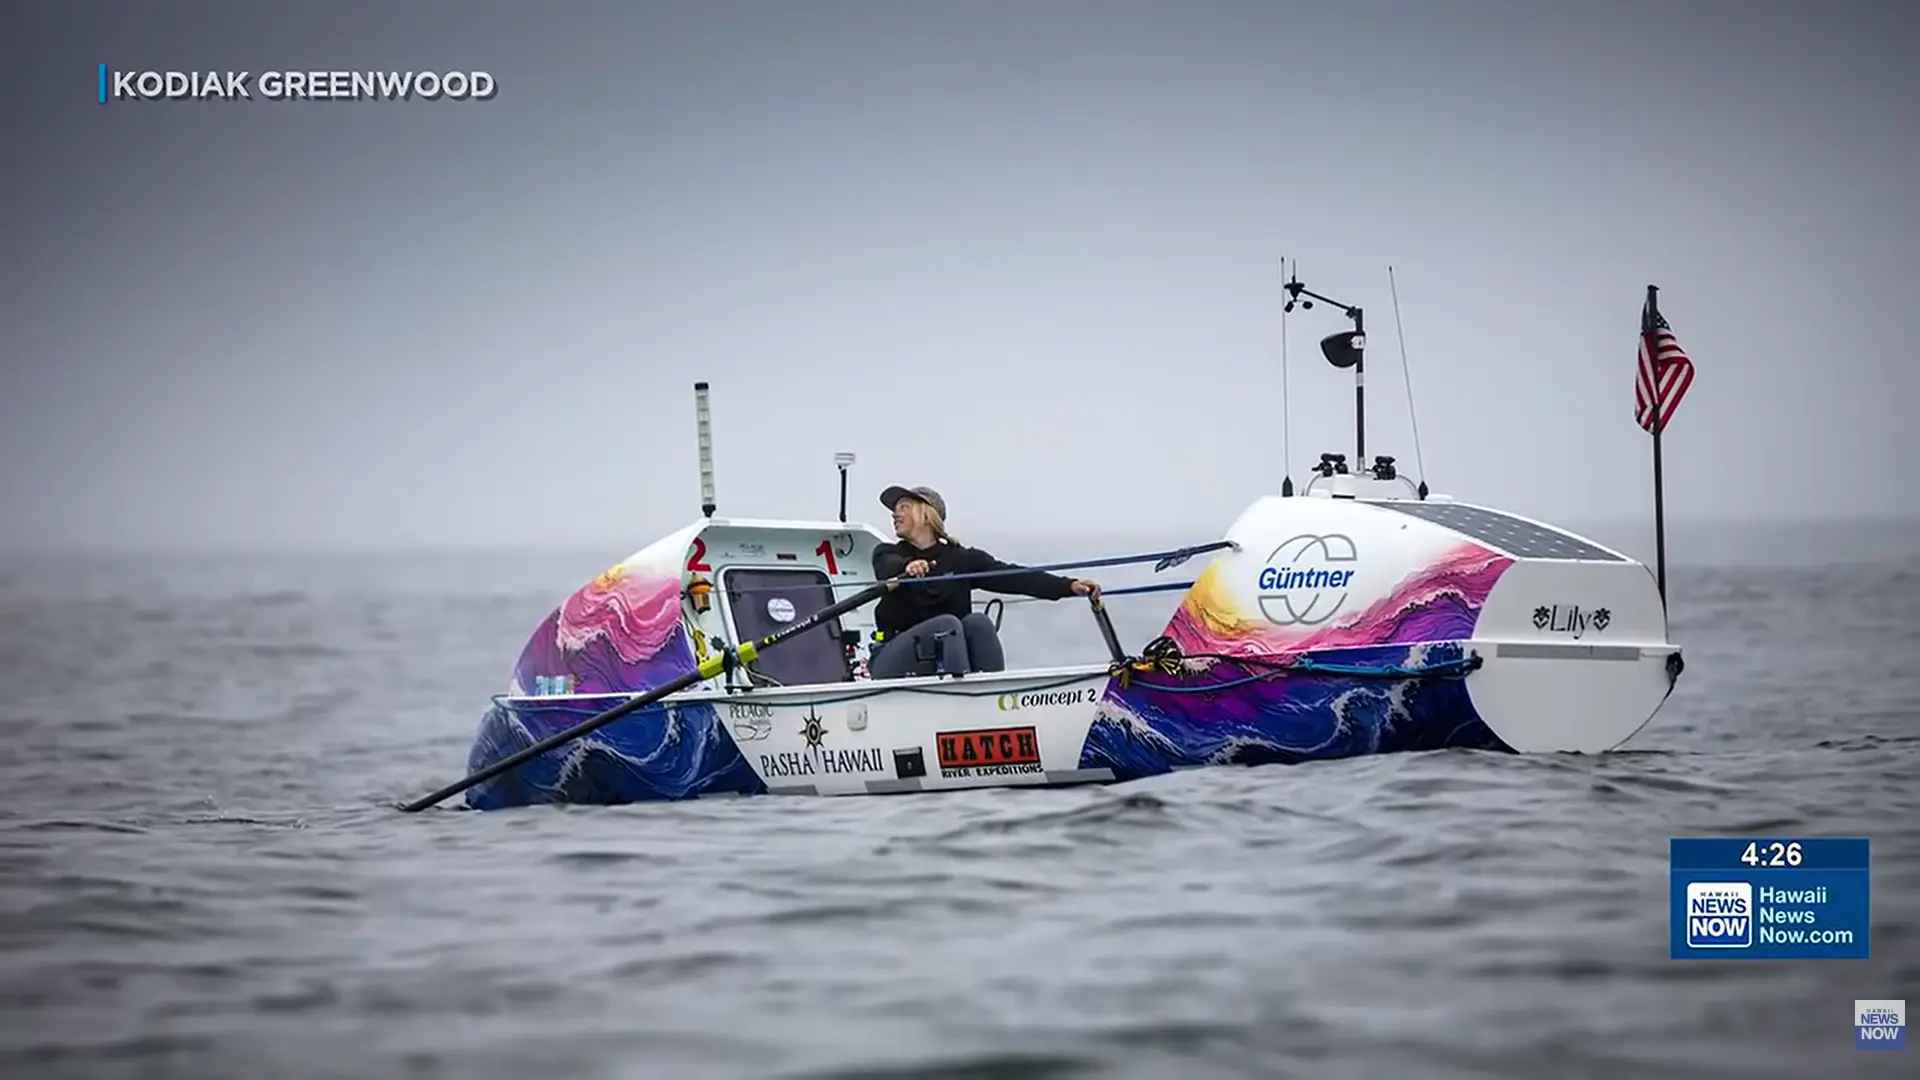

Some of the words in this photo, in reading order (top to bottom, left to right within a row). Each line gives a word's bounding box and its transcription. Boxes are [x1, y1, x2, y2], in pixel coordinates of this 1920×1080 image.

[687, 536, 712, 572] 2
[815, 540, 838, 575] 1
[1258, 567, 1355, 590] Güntner
[1550, 604, 1592, 640] Lily
[1021, 690, 1083, 708] concept
[1087, 689, 1097, 703] 2
[941, 732, 1037, 762] HATCH
[760, 752, 815, 778] PASHA
[822, 748, 884, 774] HAWAII
[941, 767, 971, 779] RIVER
[976, 763, 1044, 777] EXPEDITIONS
